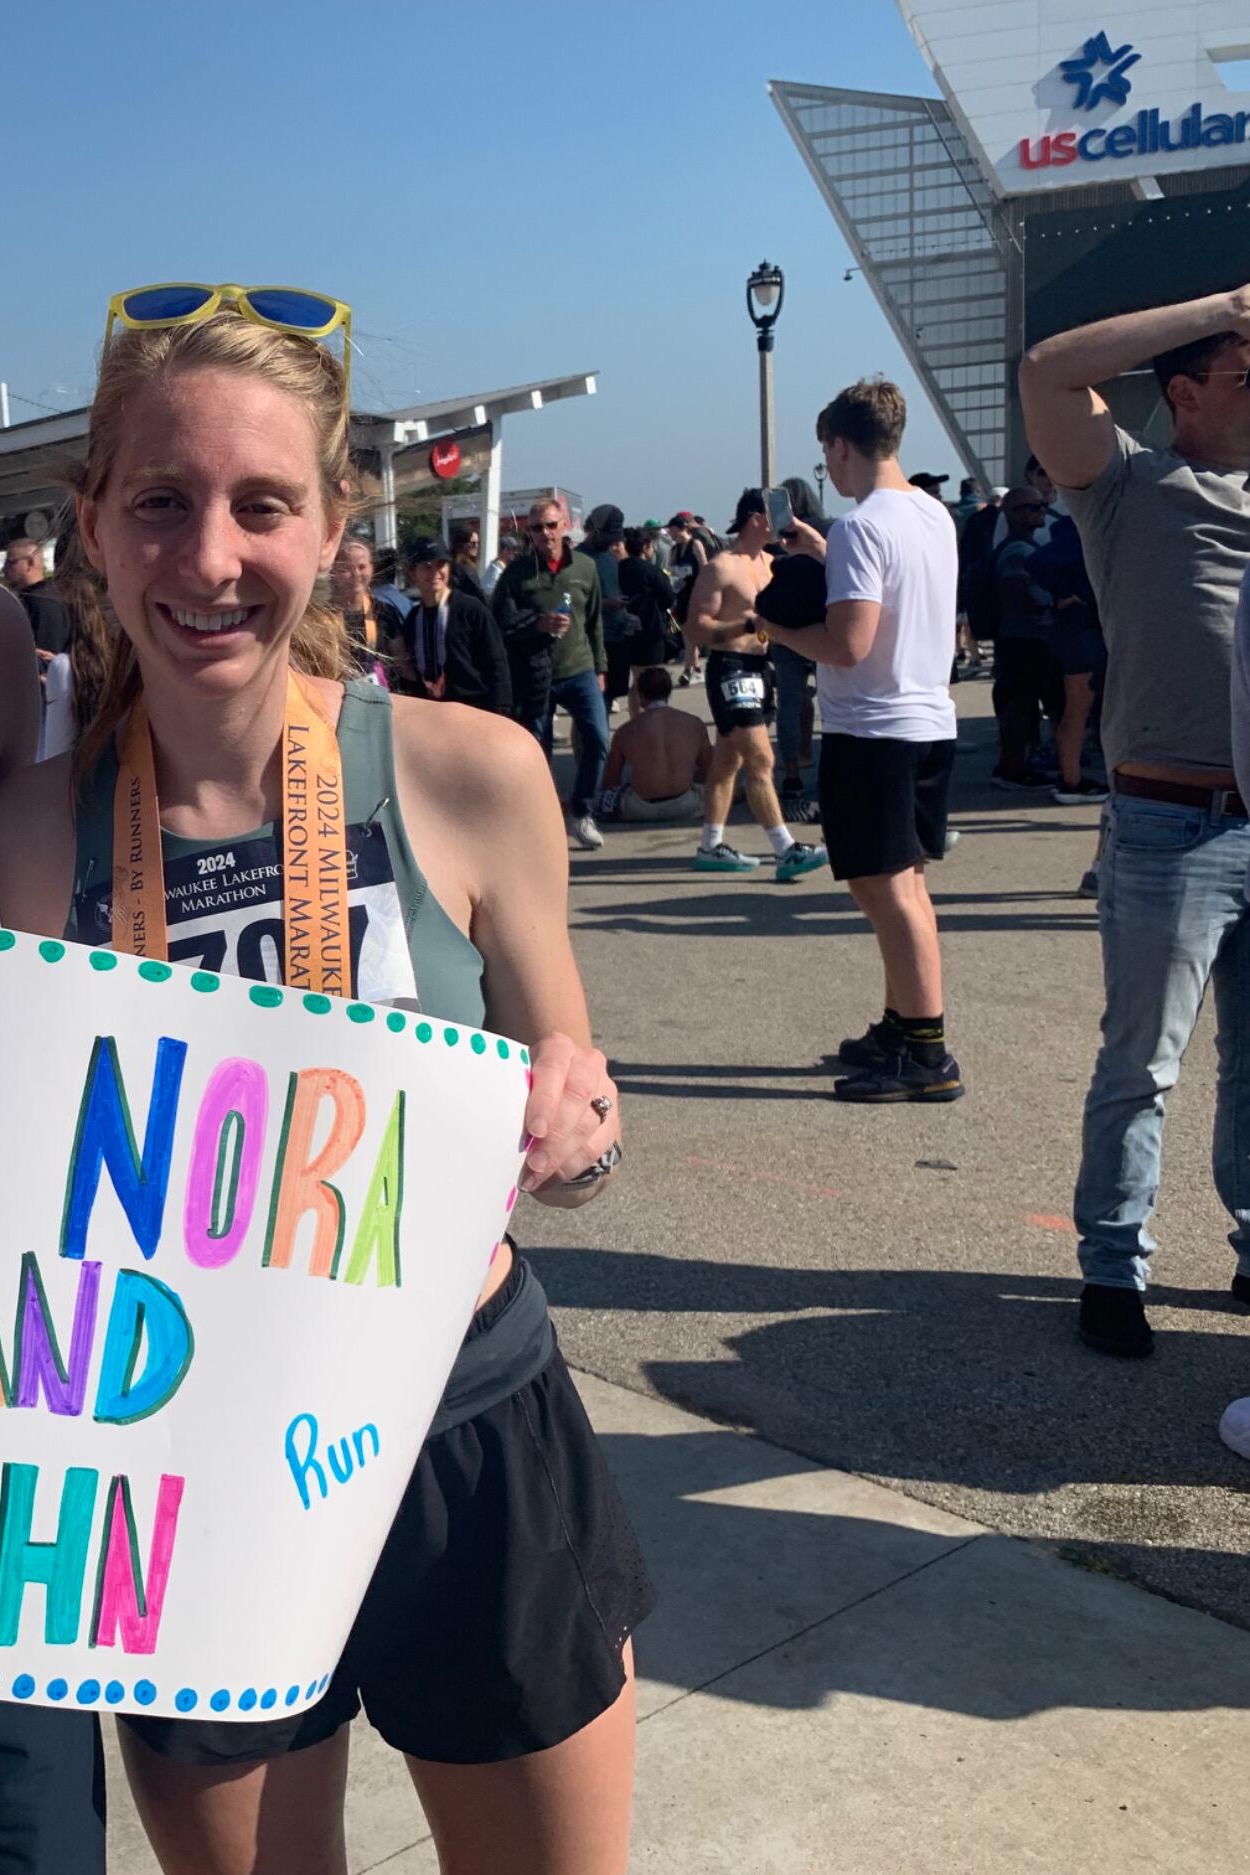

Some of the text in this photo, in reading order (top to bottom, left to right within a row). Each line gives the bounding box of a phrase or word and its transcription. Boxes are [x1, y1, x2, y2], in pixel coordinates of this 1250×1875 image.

[130, 776, 142, 864] RUNNERS
[288, 724, 310, 888] LAKEFRONT
[316, 774, 340, 839] 2024
[130, 870, 145, 892] BY
[181, 884, 267, 914] MARATHON
[196, 851, 236, 876] 2024
[59, 1035, 406, 1288] NORA
[285, 1413, 380, 1510] Run
